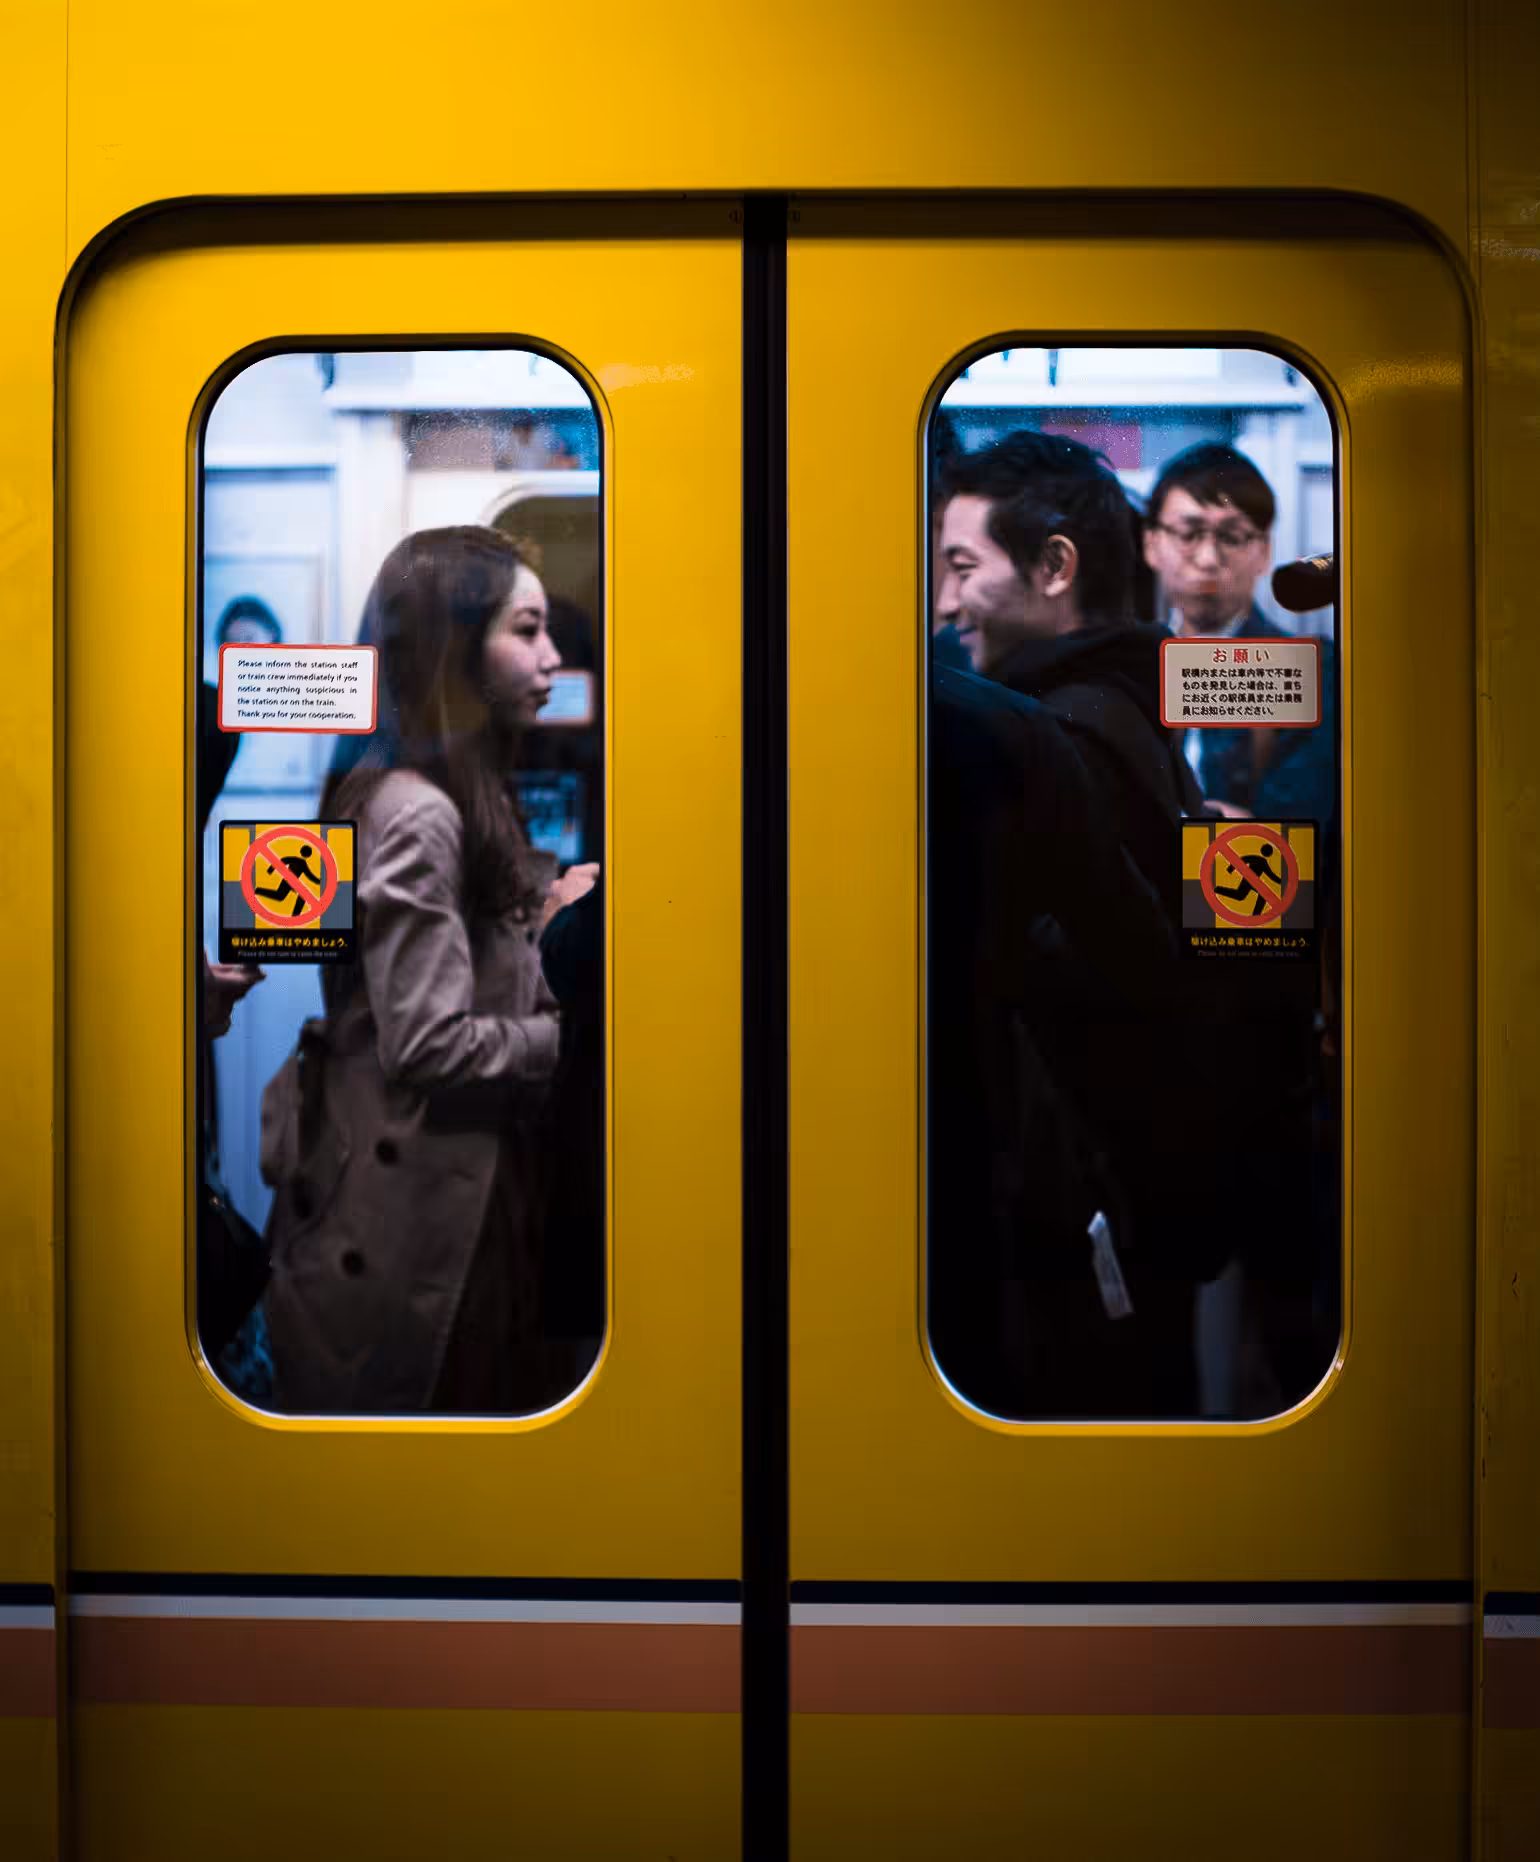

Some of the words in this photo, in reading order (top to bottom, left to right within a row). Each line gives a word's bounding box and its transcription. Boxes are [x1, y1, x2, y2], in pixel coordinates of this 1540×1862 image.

[1213, 648, 1269, 663] お願い
[287, 674, 334, 682] immediately
[337, 673, 342, 681] if
[266, 686, 300, 694] anything
[306, 686, 345, 694] suspicious
[309, 712, 356, 720] cooperation.
